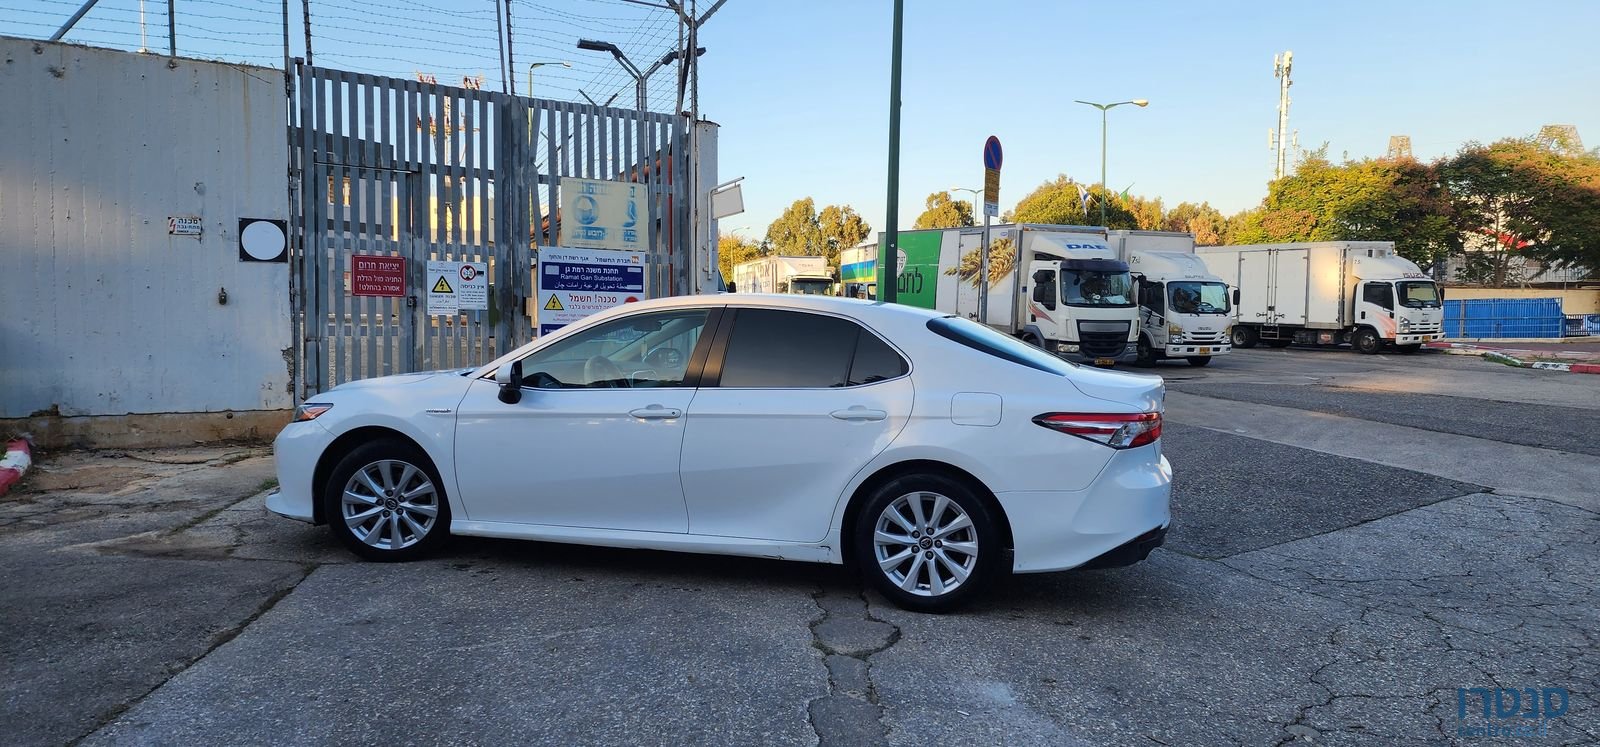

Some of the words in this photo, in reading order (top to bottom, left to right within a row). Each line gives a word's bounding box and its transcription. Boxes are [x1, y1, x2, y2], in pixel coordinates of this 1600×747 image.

[358, 261, 376, 269] חרום
[379, 262, 400, 270] יציאת
[565, 266, 571, 274] גן
[568, 293, 592, 302] חשמל
[594, 294, 617, 303] סכנה!
